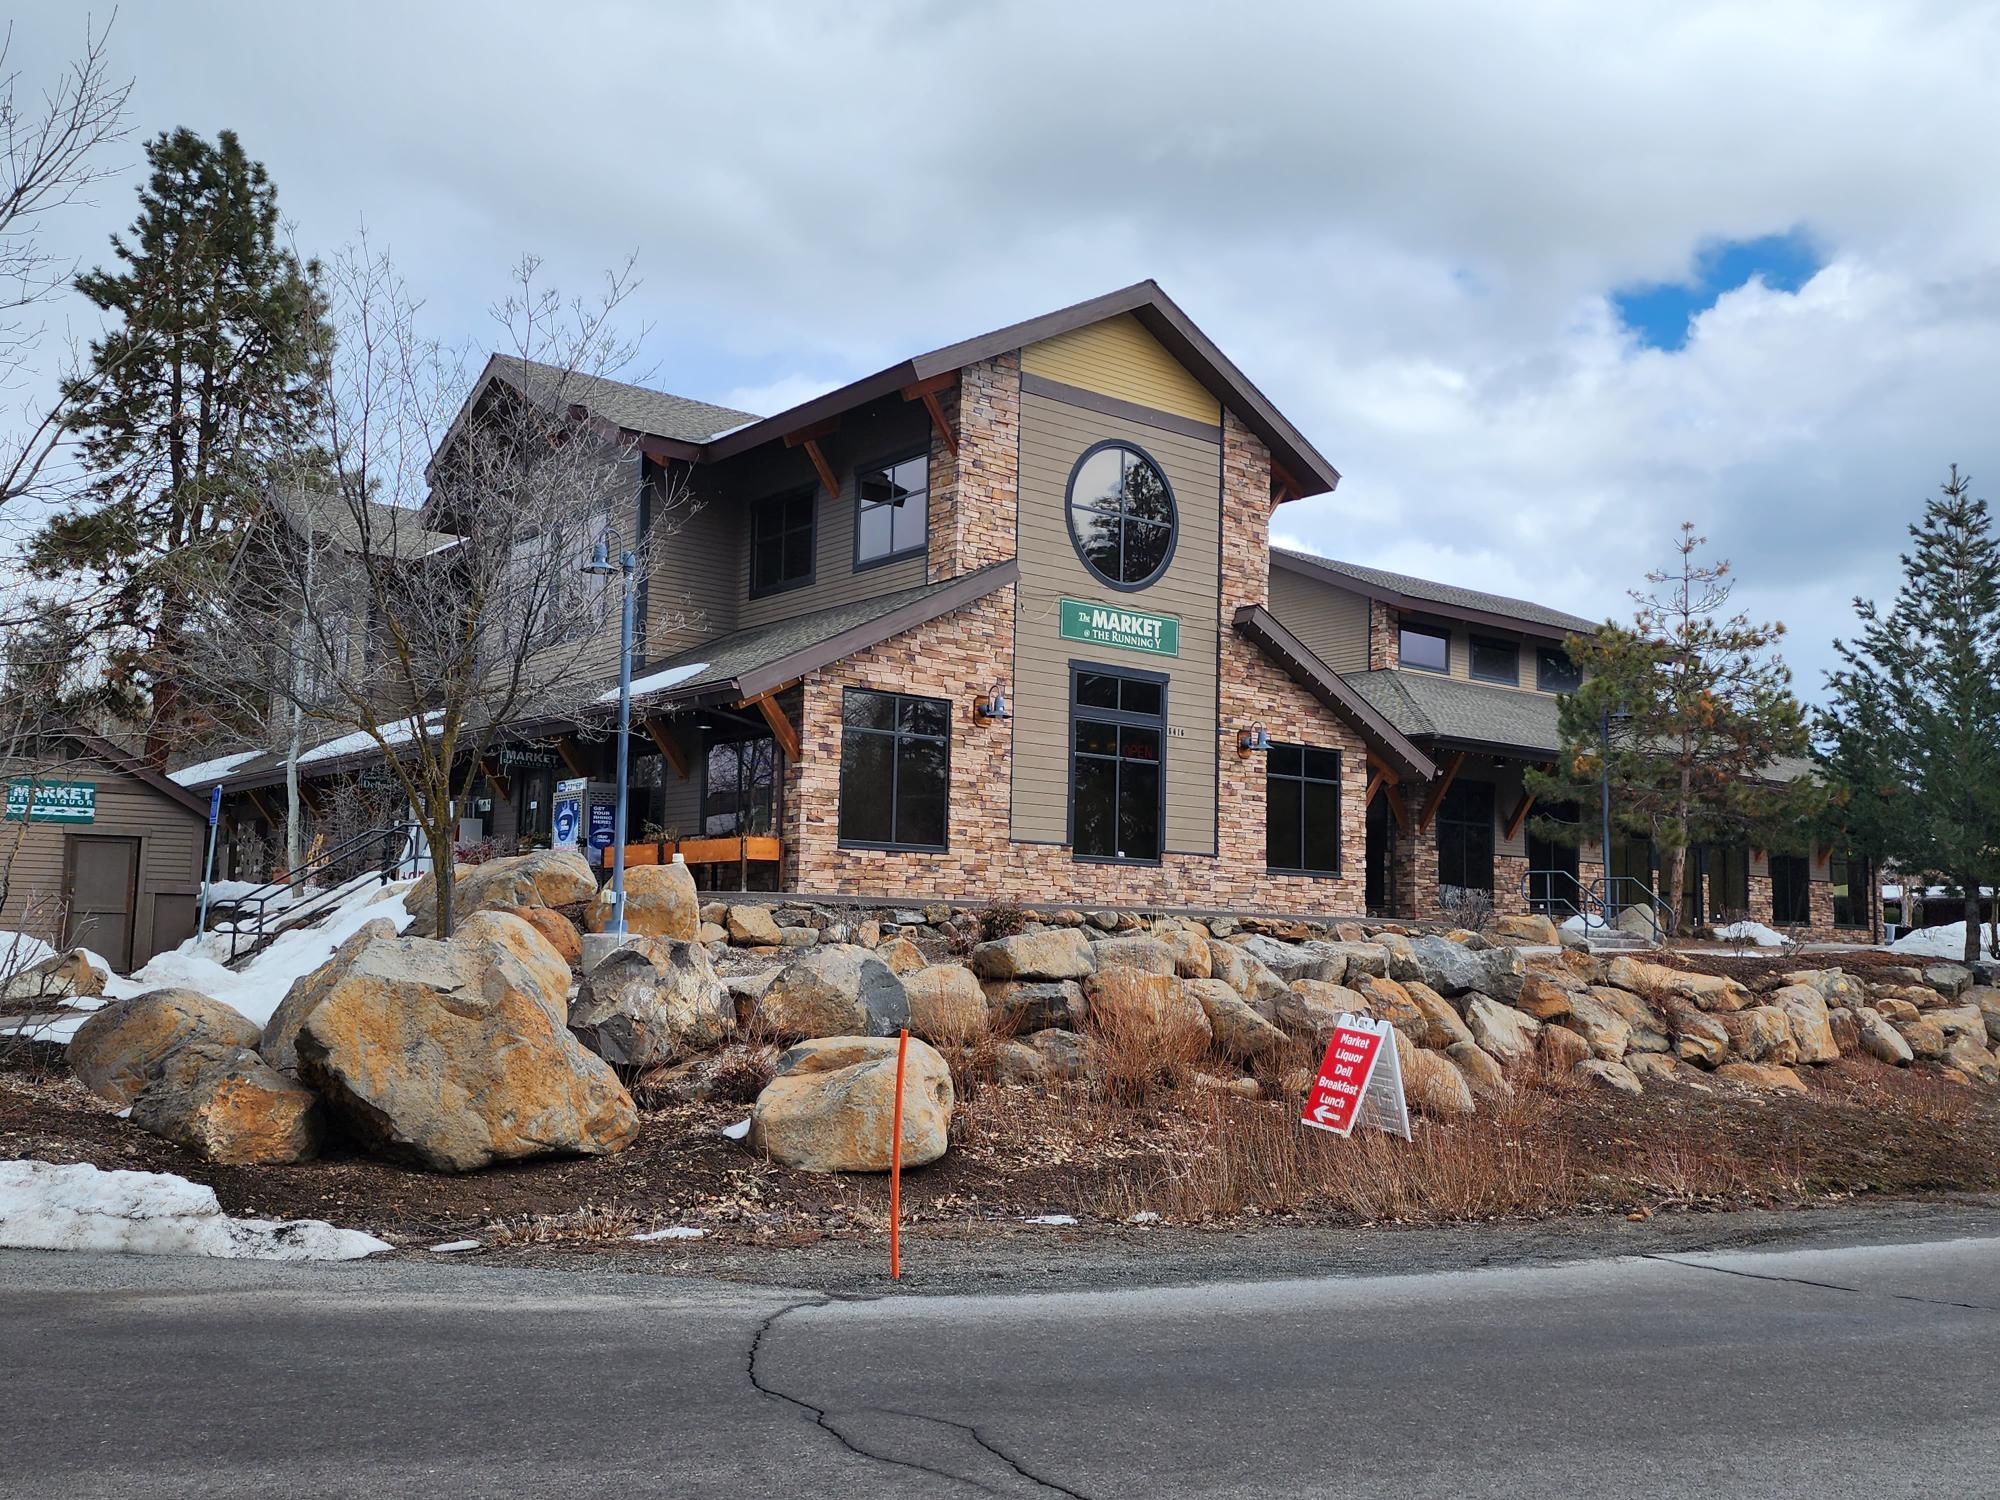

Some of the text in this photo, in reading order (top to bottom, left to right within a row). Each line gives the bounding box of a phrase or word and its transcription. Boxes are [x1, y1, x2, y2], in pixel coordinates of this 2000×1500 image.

[1078, 609, 1162, 638] The MARKET
[1084, 629, 1162, 649] @ THE RUNNING Y
[506, 749, 559, 764] MARKET
[1121, 744, 1153, 759] OPEN
[13, 785, 95, 801] MARKET
[1340, 1033, 1370, 1049] Market
[1335, 1048, 1364, 1064] Liquor
[1334, 1063, 1354, 1077] Deli
[1318, 1075, 1359, 1096] Breakfast
[1319, 1092, 1346, 1109] Lunch
